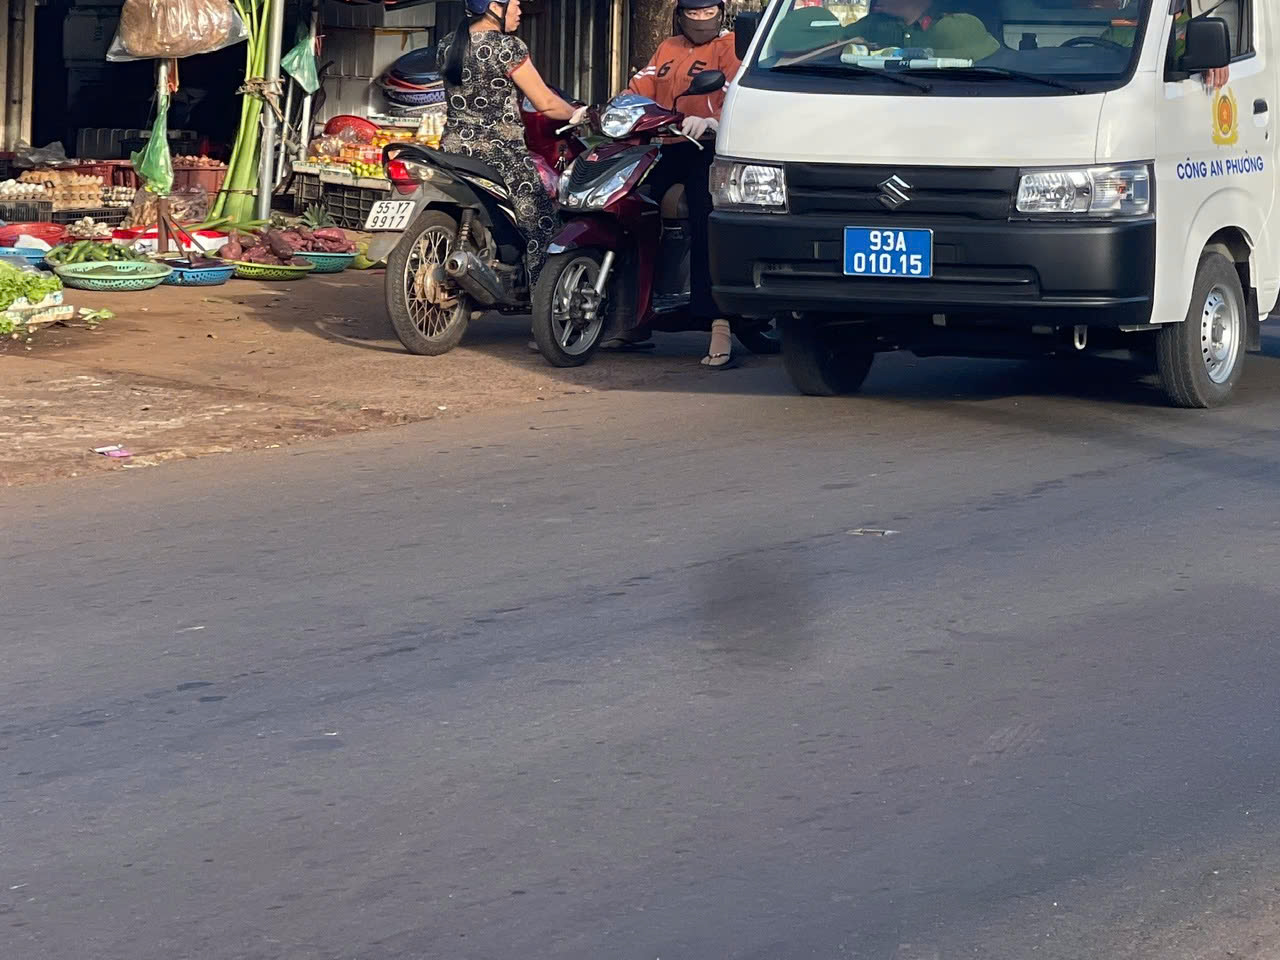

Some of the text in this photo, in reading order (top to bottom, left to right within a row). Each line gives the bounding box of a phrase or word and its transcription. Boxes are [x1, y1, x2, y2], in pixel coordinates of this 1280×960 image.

[1176, 157, 1207, 180] CÔNG
[1210, 160, 1224, 177] AN
[376, 202, 411, 214] 55-Y7
[370, 215, 405, 228] 9917
[869, 230, 907, 252] 93A
[853, 252, 923, 275] 010.15
